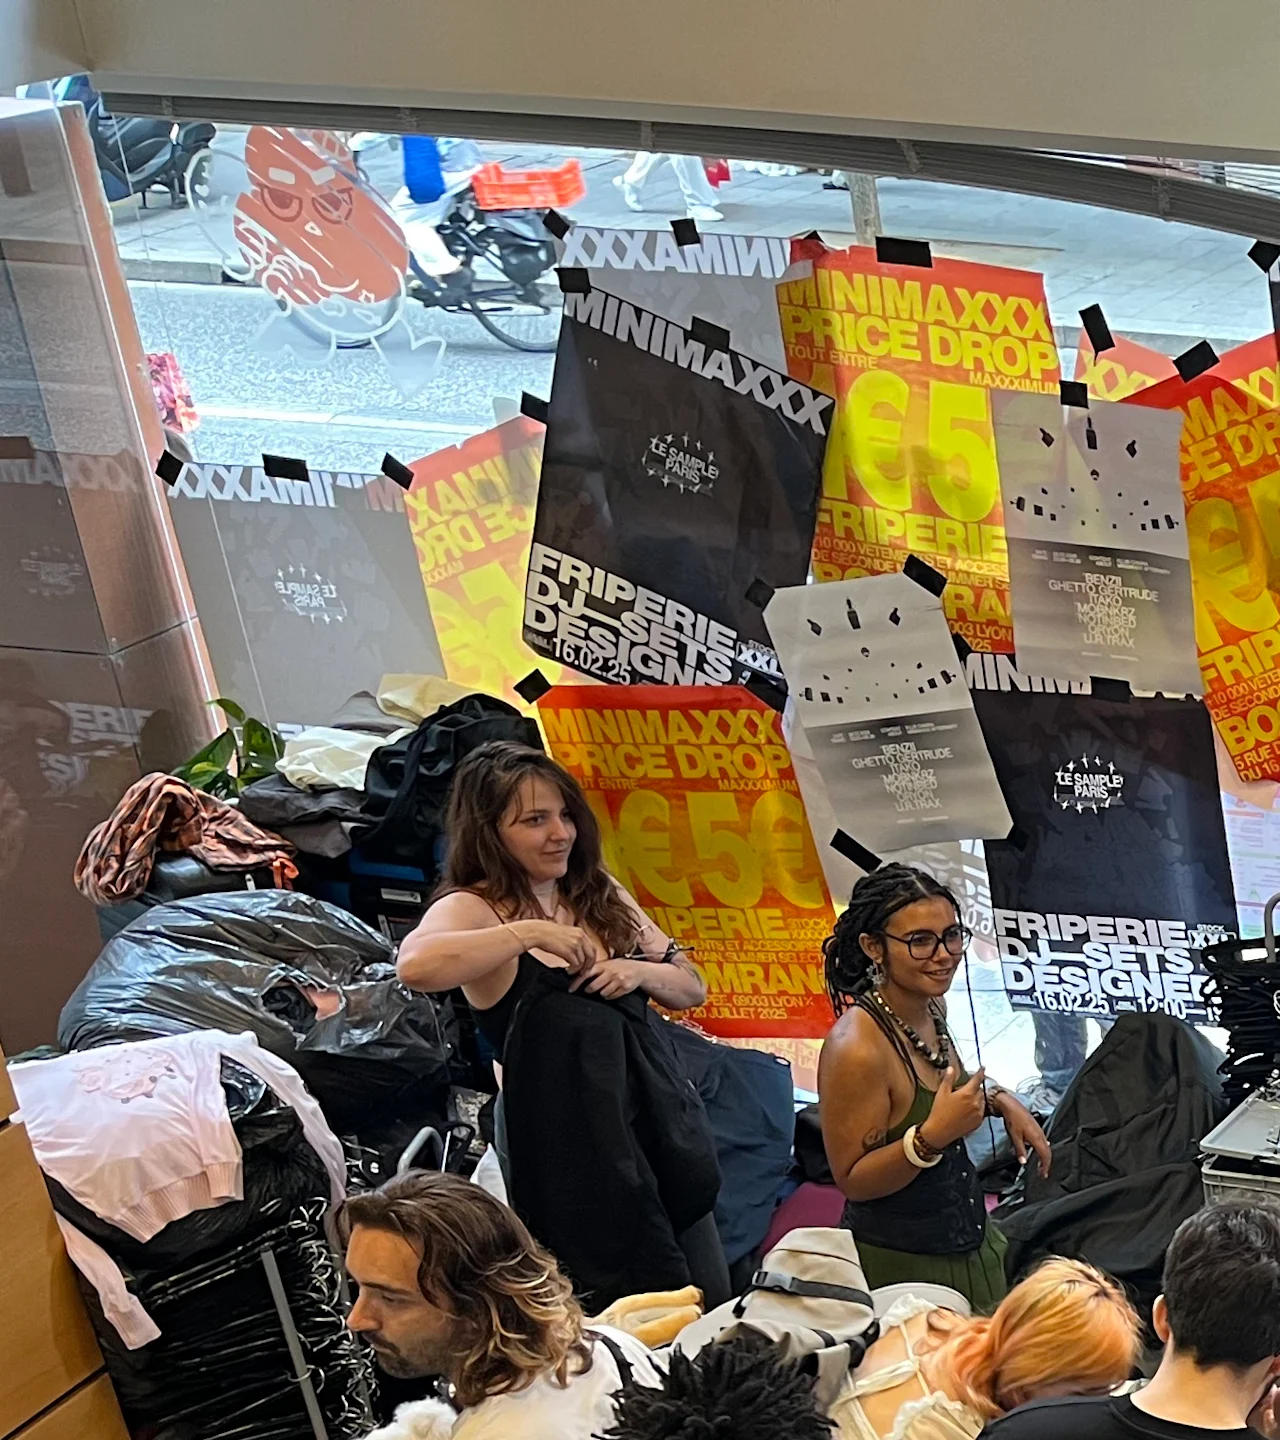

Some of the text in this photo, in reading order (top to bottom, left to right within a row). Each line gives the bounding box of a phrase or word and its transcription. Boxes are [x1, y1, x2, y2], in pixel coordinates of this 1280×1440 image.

[777, 268, 1051, 341] MINIMAXXX
[780, 306, 1059, 379] PRICE DROP
[565, 291, 834, 436] MINIMAXXX
[787, 344, 878, 369] TOUT ENTRE
[529, 541, 737, 657] FRIPERIE
[1048, 579, 1159, 602] GHETTO GERTRUDE
[553, 636, 632, 686] 16.02.25
[1228, 681, 1249, 699] 000
[540, 708, 781, 745] MINIMAXXX
[1213, 706, 1231, 722] DE
[555, 743, 792, 779] PRICE DROP
[852, 747, 954, 769] GHETTO GERTRUDE
[1235, 757, 1244, 771] 5
[1245, 745, 1273, 766] RUE
[1240, 766, 1261, 782] DU
[1262, 757, 1280, 773] 16
[599, 777, 640, 790] ENTRE
[718, 778, 798, 793] MAXXXIMUM
[1058, 773, 1122, 788] LE SAMPLE
[1074, 785, 1109, 798] PARIS
[686, 790, 826, 910] 5€
[994, 908, 1191, 949] FRIPERIE
[1197, 924, 1224, 933] STOCK
[726, 951, 777, 963] SUMMER
[709, 1007, 788, 1019] JUILLET 2025
[770, 995, 804, 1007] LYON
[1033, 989, 1109, 1015] 16.02.25
